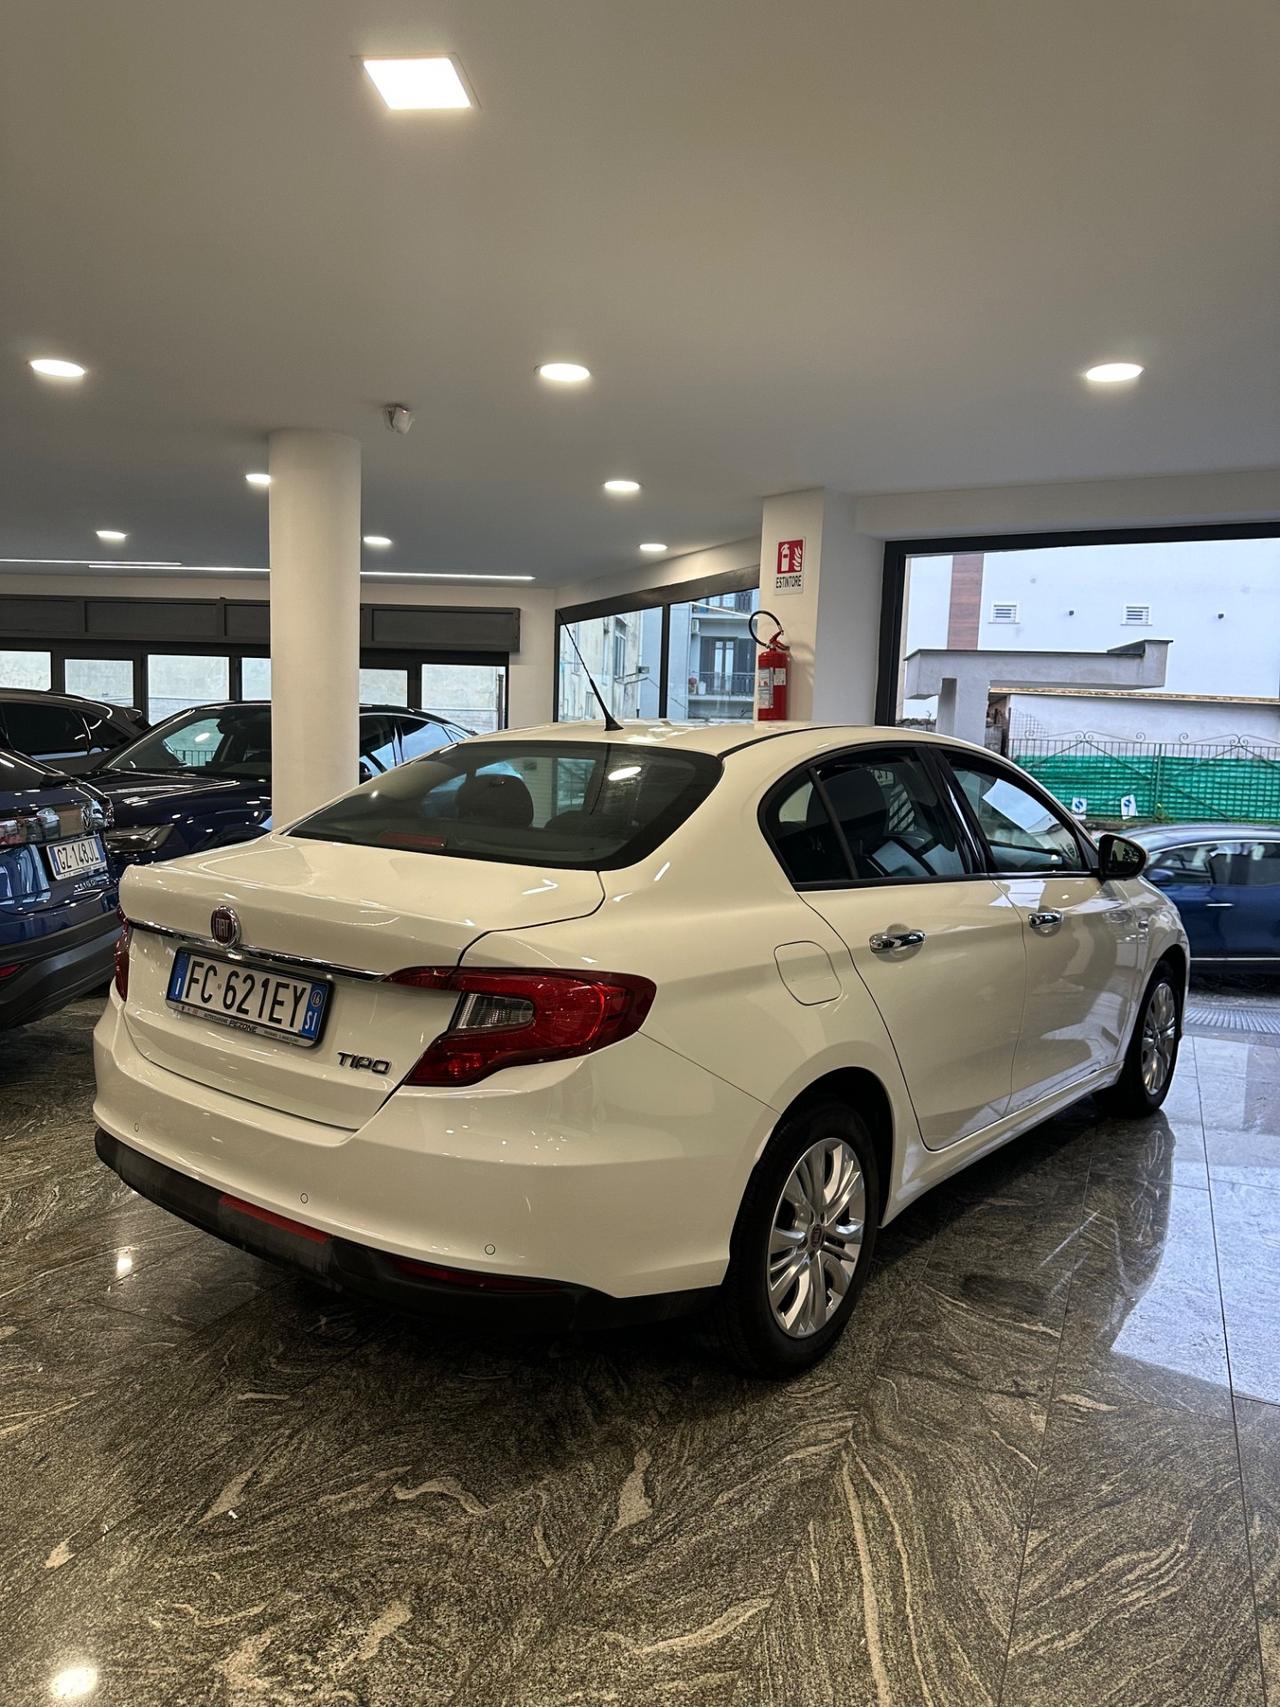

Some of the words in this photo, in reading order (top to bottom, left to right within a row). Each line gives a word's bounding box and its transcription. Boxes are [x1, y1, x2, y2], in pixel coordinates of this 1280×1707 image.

[776, 575, 802, 589] ESTINTORE
[215, 917, 230, 937] FIAT
[185, 960, 218, 1004] FC
[222, 970, 307, 1028] 621EY
[304, 1011, 318, 1031] SI
[337, 1051, 392, 1074] TIPO
